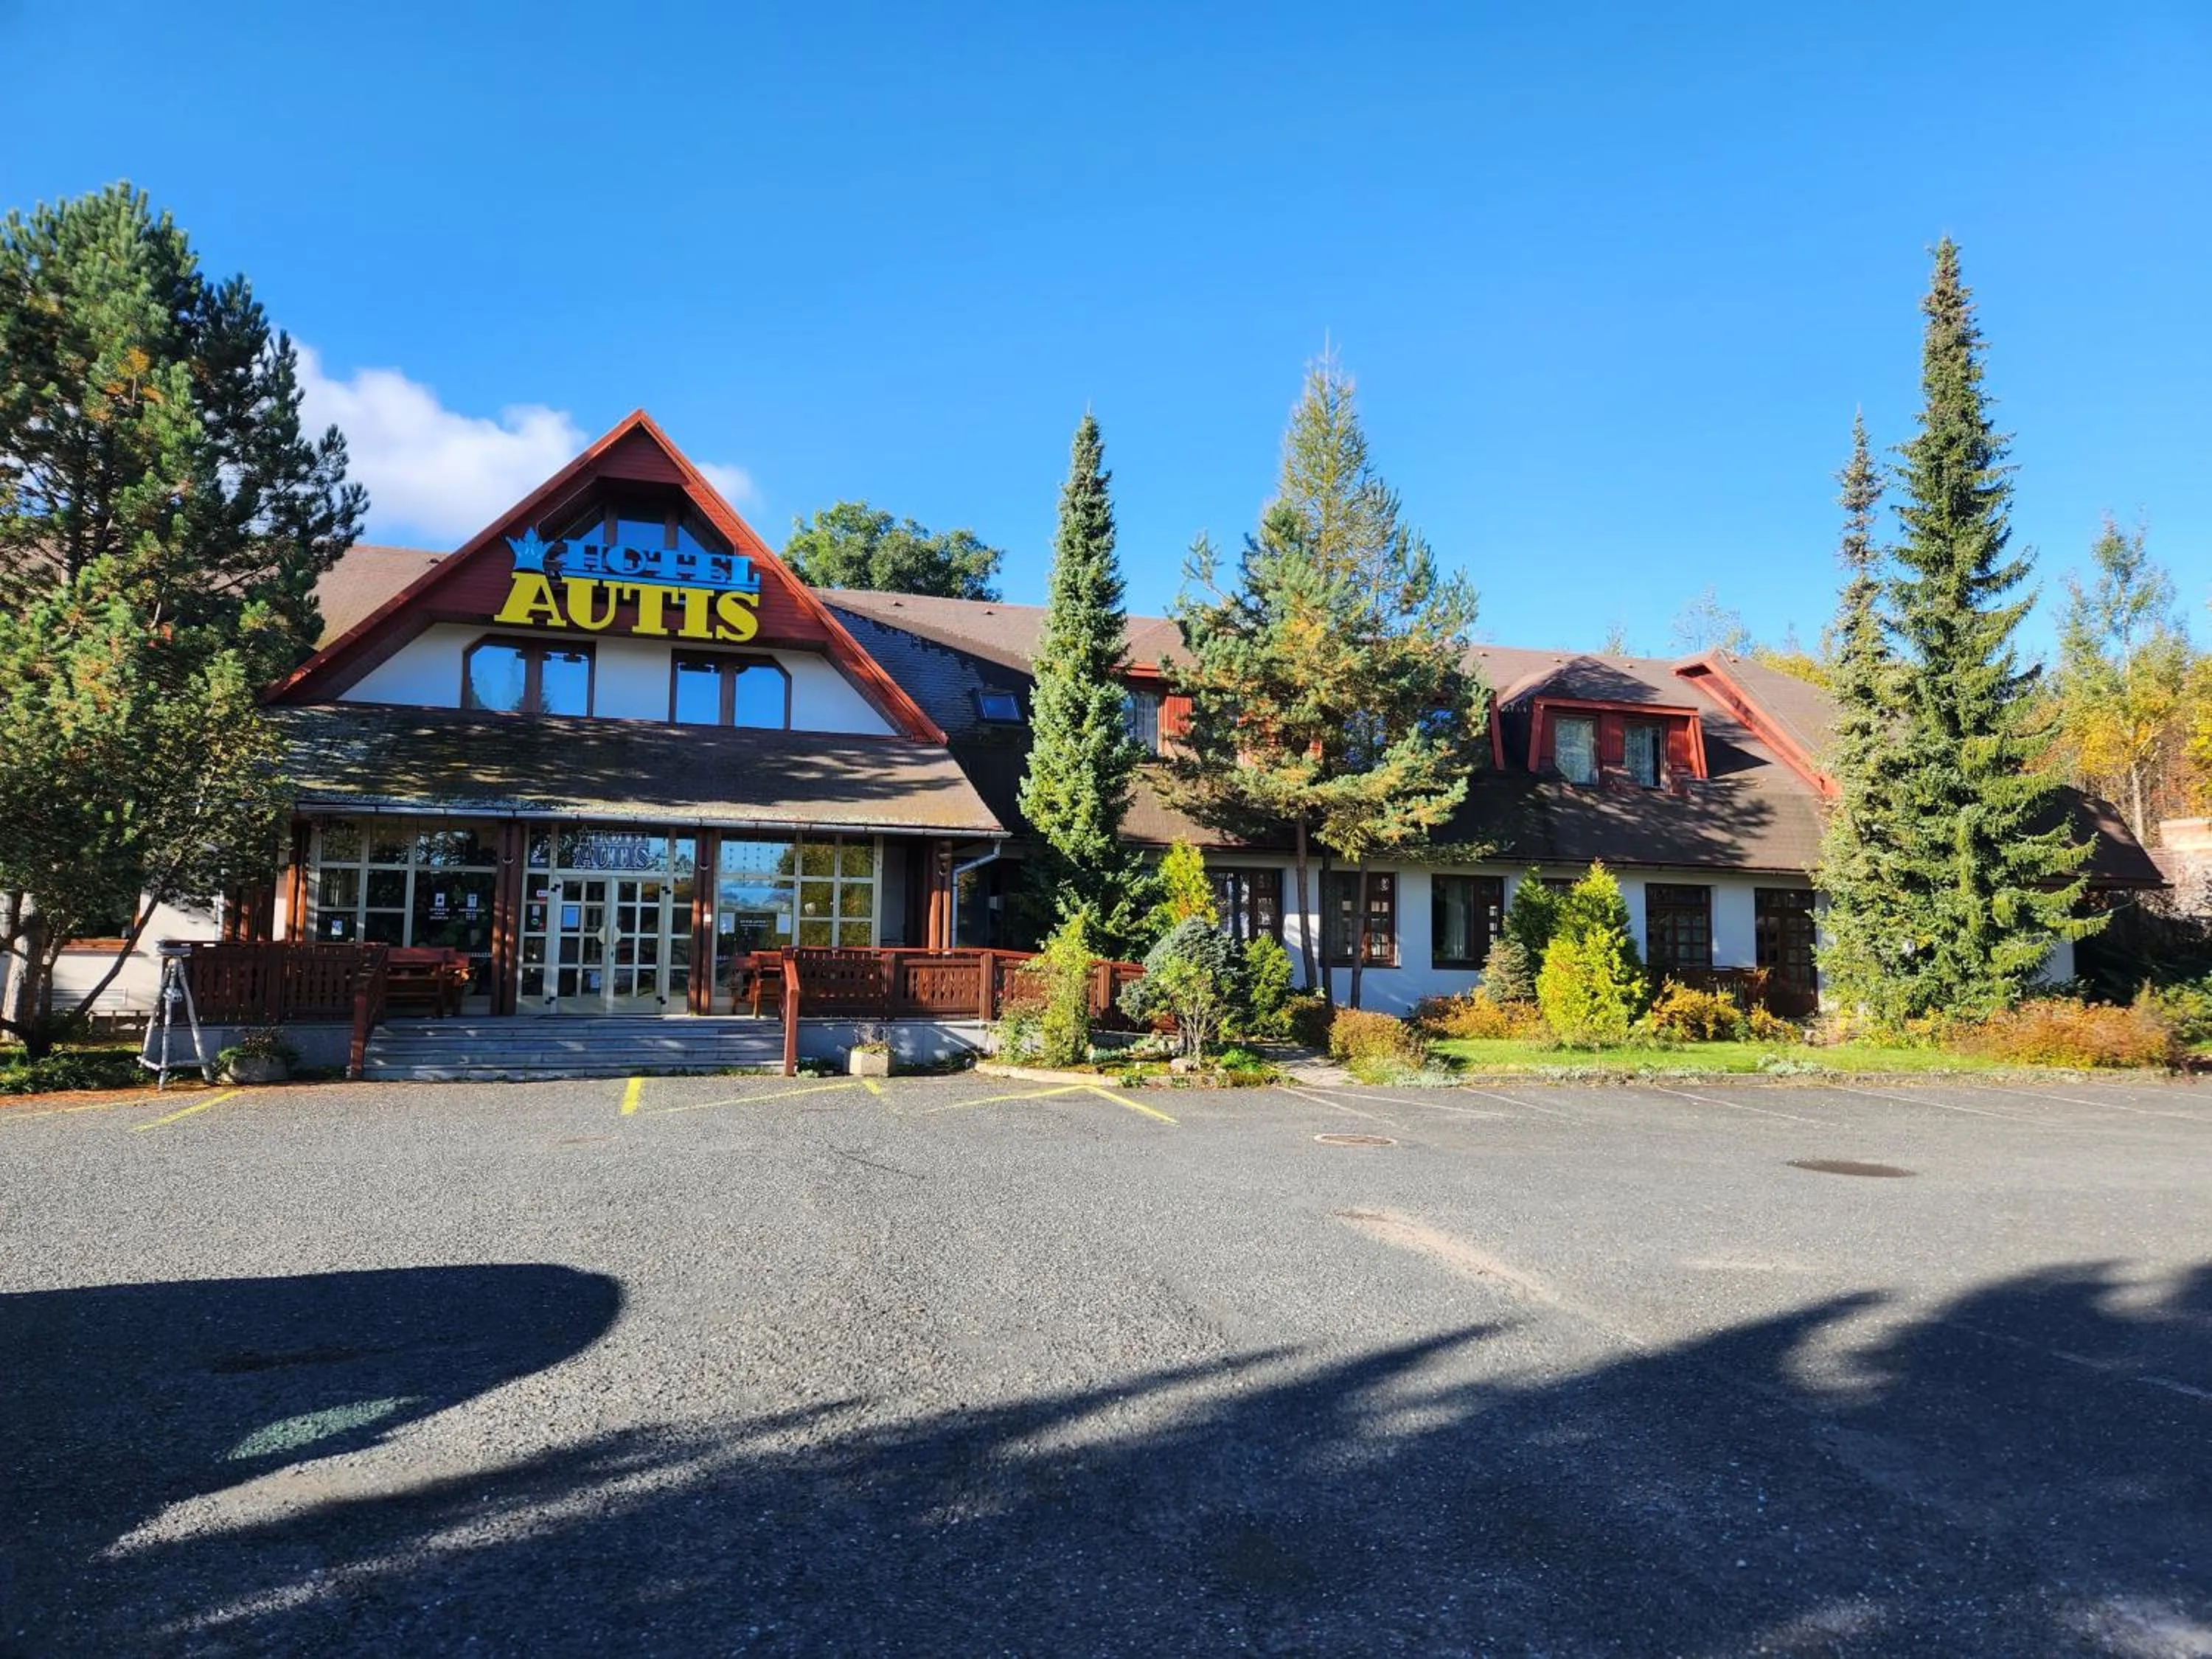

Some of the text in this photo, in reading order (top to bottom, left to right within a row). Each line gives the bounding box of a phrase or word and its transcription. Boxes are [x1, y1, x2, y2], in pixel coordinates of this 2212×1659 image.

[562, 539, 761, 587] HOTEL
[493, 571, 759, 642] AUTIS
[573, 844, 650, 869] AUTIS
